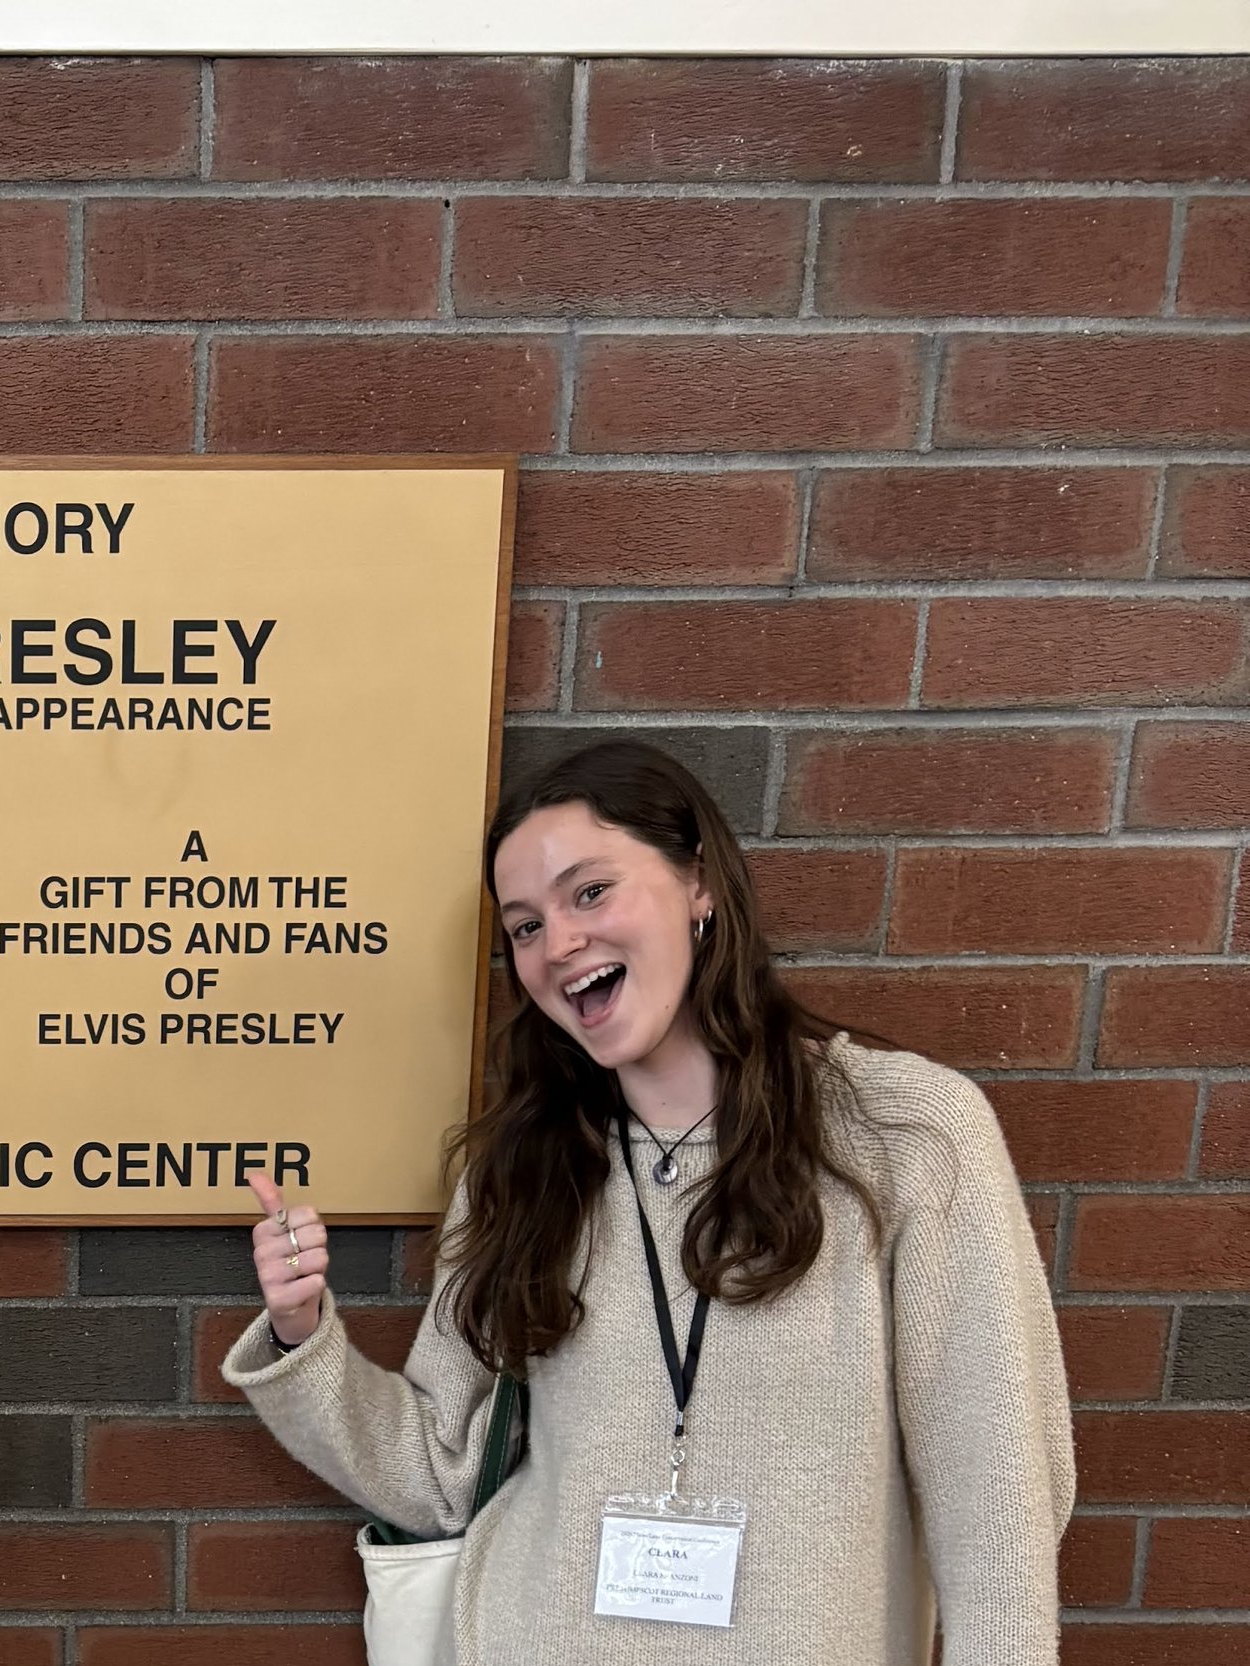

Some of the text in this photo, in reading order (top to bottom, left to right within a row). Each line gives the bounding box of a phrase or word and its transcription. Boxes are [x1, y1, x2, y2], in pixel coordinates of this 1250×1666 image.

[180, 830, 209, 862] A
[40, 875, 348, 909] GIFT FROM THE
[184, 921, 271, 955] AND
[284, 921, 388, 955] FANS
[164, 967, 219, 1000] OF
[38, 1012, 345, 1046] ELVIS PRESLEY
[73, 1141, 311, 1189] CENTER
[648, 1547, 688, 1560] CLARA
[652, 1596, 675, 1605] TRUST
[660, 1589, 698, 1600] REGIONAL
[700, 1592, 724, 1601] LAND
